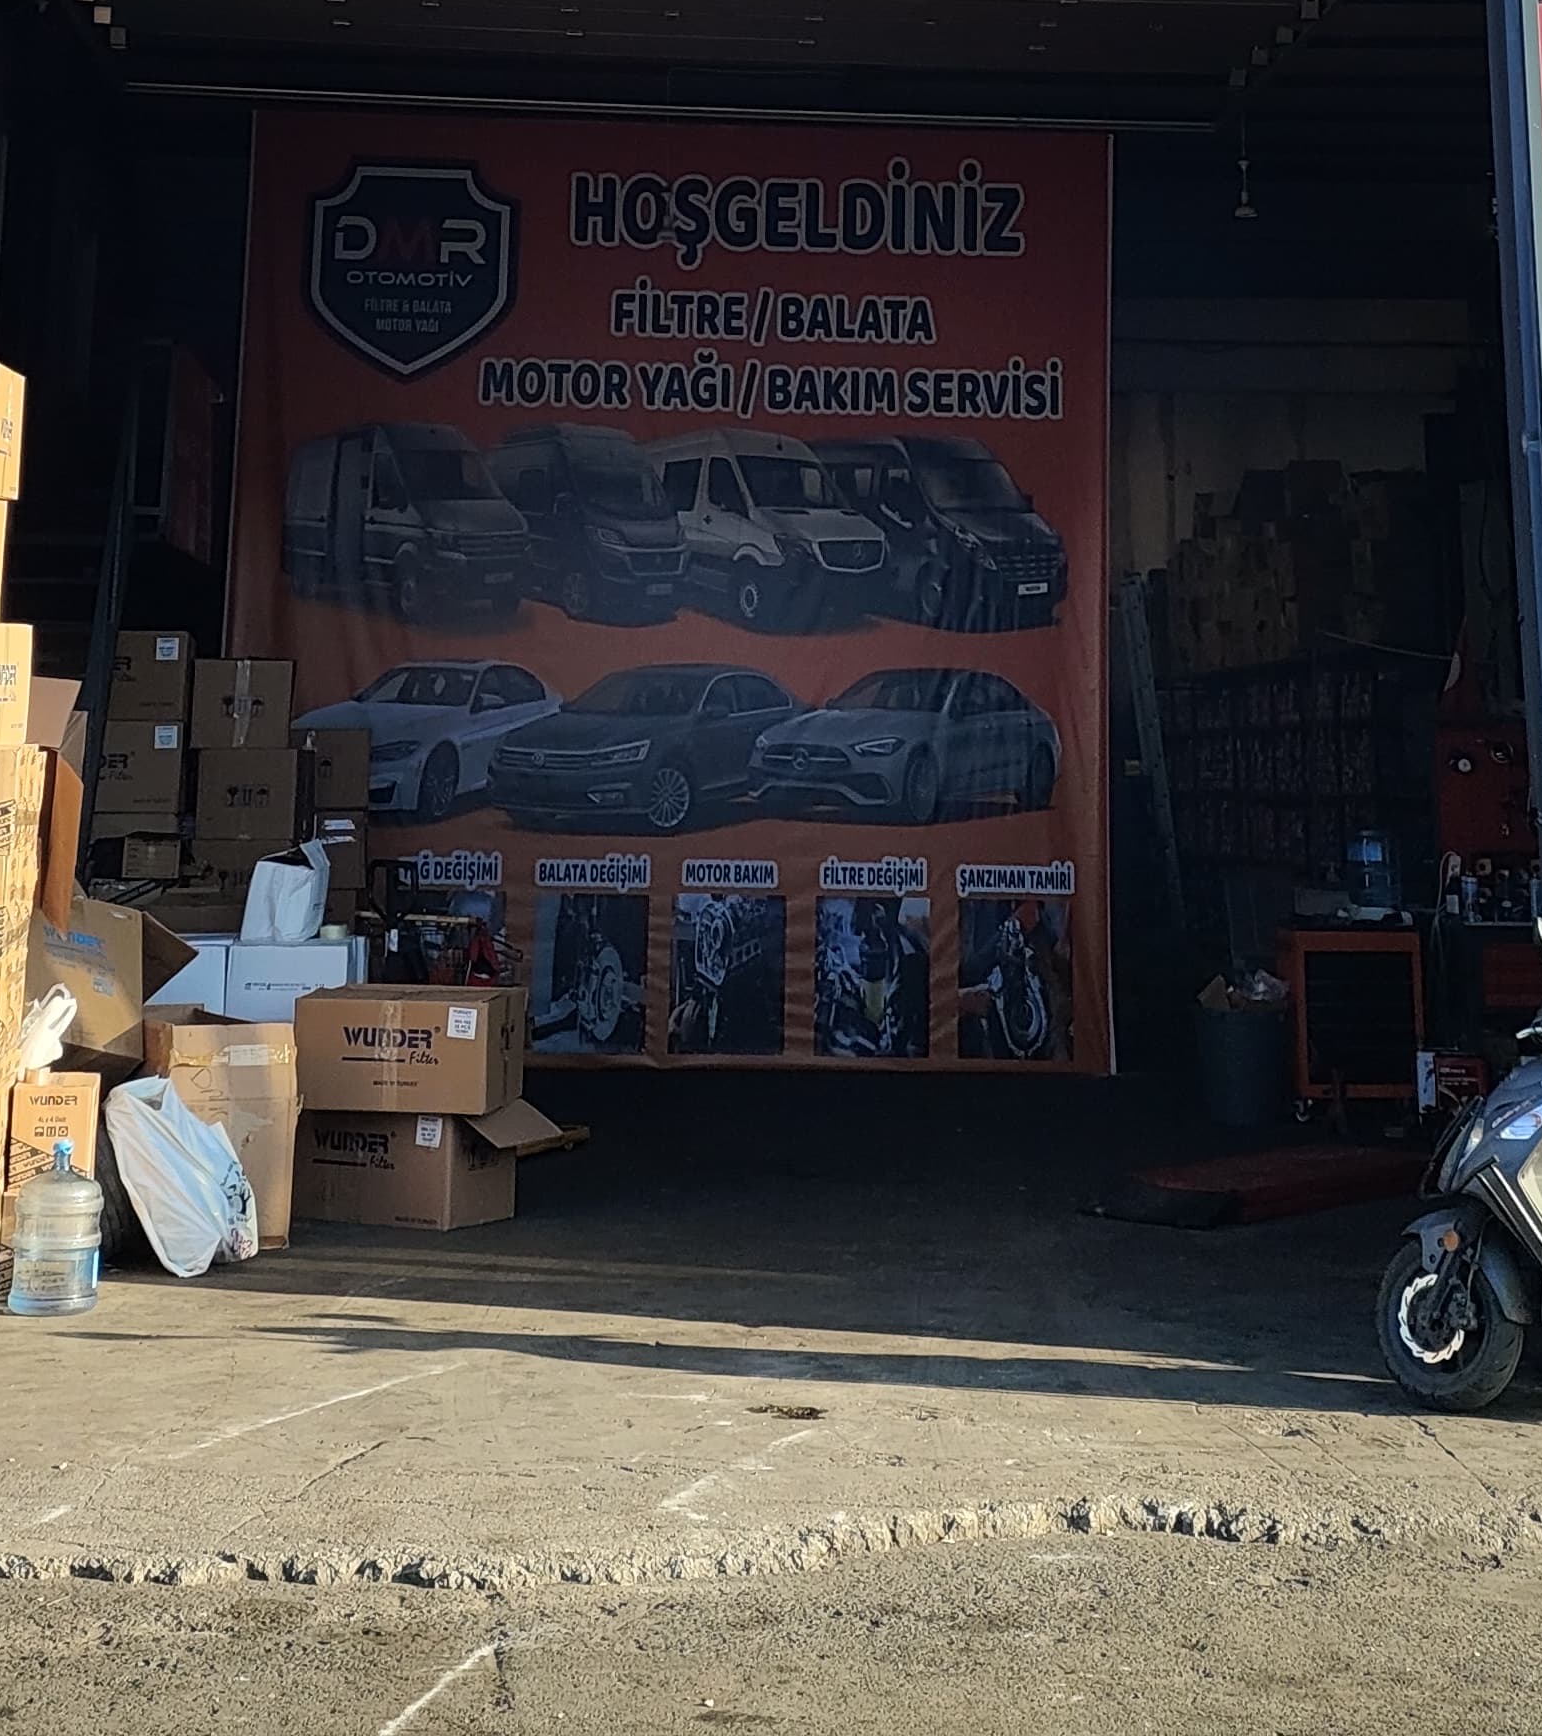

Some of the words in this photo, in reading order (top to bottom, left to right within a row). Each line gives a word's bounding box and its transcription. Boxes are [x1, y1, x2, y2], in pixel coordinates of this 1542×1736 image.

[570, 156, 1027, 269] HOŞGELDİNİZ
[334, 215, 487, 264] DMR
[346, 270, 473, 287] OTOMOTİV
[364, 297, 400, 313] FİLTRE
[412, 300, 452, 314] BALATA
[611, 276, 749, 337] FİLTRE
[751, 288, 774, 346] /
[777, 295, 937, 344] BALATA
[375, 318, 412, 332] MOTOR
[479, 359, 630, 408] MOTOR
[637, 349, 735, 413] YAĞI
[736, 360, 760, 419] /
[764, 365, 899, 417] BAKIM
[904, 356, 1063, 419] SERVİSİ
[434, 853, 499, 886] DEĞİŞİMİ
[538, 861, 588, 884] BALATA
[590, 858, 648, 889] DEĞİŞİMİ
[685, 863, 732, 884] MOTOR
[734, 863, 775, 885] BAKIM
[823, 860, 866, 886] FİLTRE
[867, 861, 925, 893] DEĞİŞİMİ
[958, 868, 1026, 893] ŞANZIMAN
[1028, 864, 1072, 891] TAMİRİ
[343, 1026, 433, 1049] WUNDER
[409, 1051, 439, 1065] Filter
[29, 1095, 78, 1105] WUNDER
